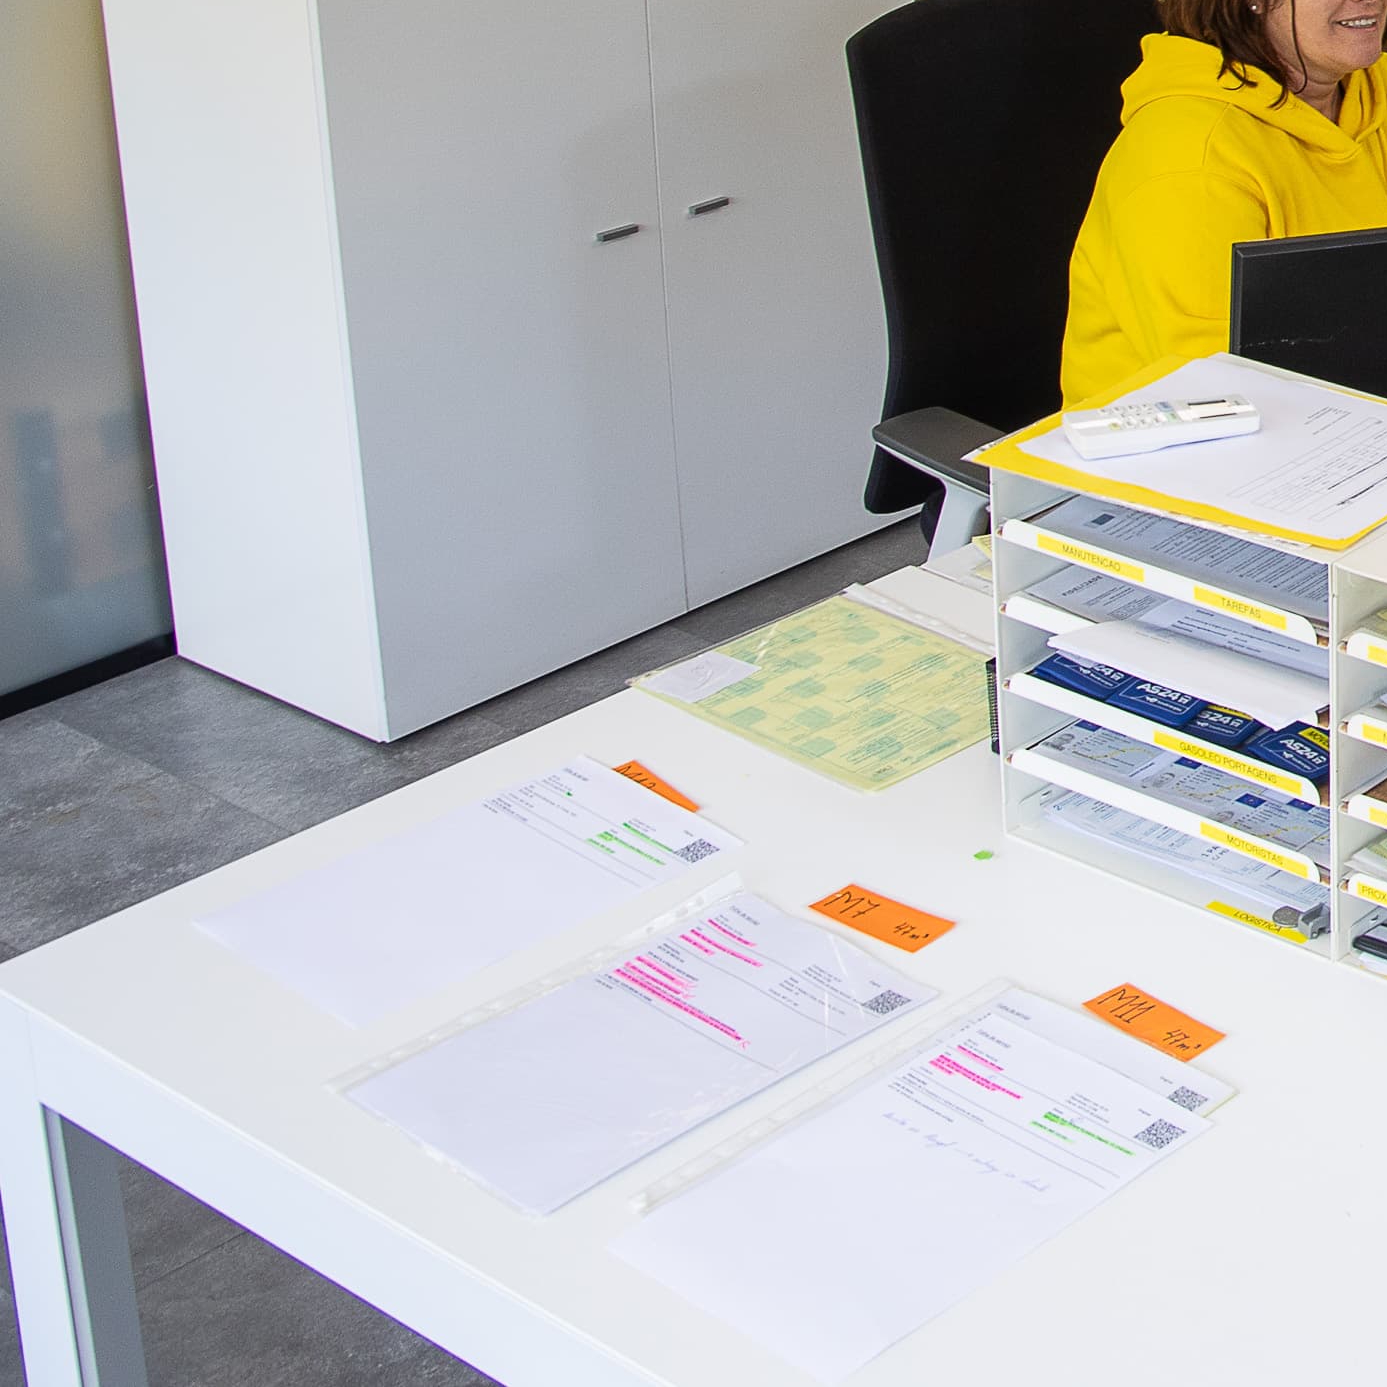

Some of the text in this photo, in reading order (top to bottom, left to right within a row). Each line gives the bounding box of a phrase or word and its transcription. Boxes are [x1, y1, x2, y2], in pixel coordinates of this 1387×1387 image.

[1062, 543, 1121, 572] MANUTENCAO
[1221, 597, 1261, 620] TAREFAS
[1137, 681, 1178, 702] AS24
[1280, 737, 1318, 761] AS24
[1222, 754, 1278, 784] PORTAGENS
[1226, 834, 1284, 866] MOTORISTAS
[823, 890, 880, 919] M7
[1234, 910, 1282, 933] LOGISTICA
[1097, 988, 1157, 1024] M11
